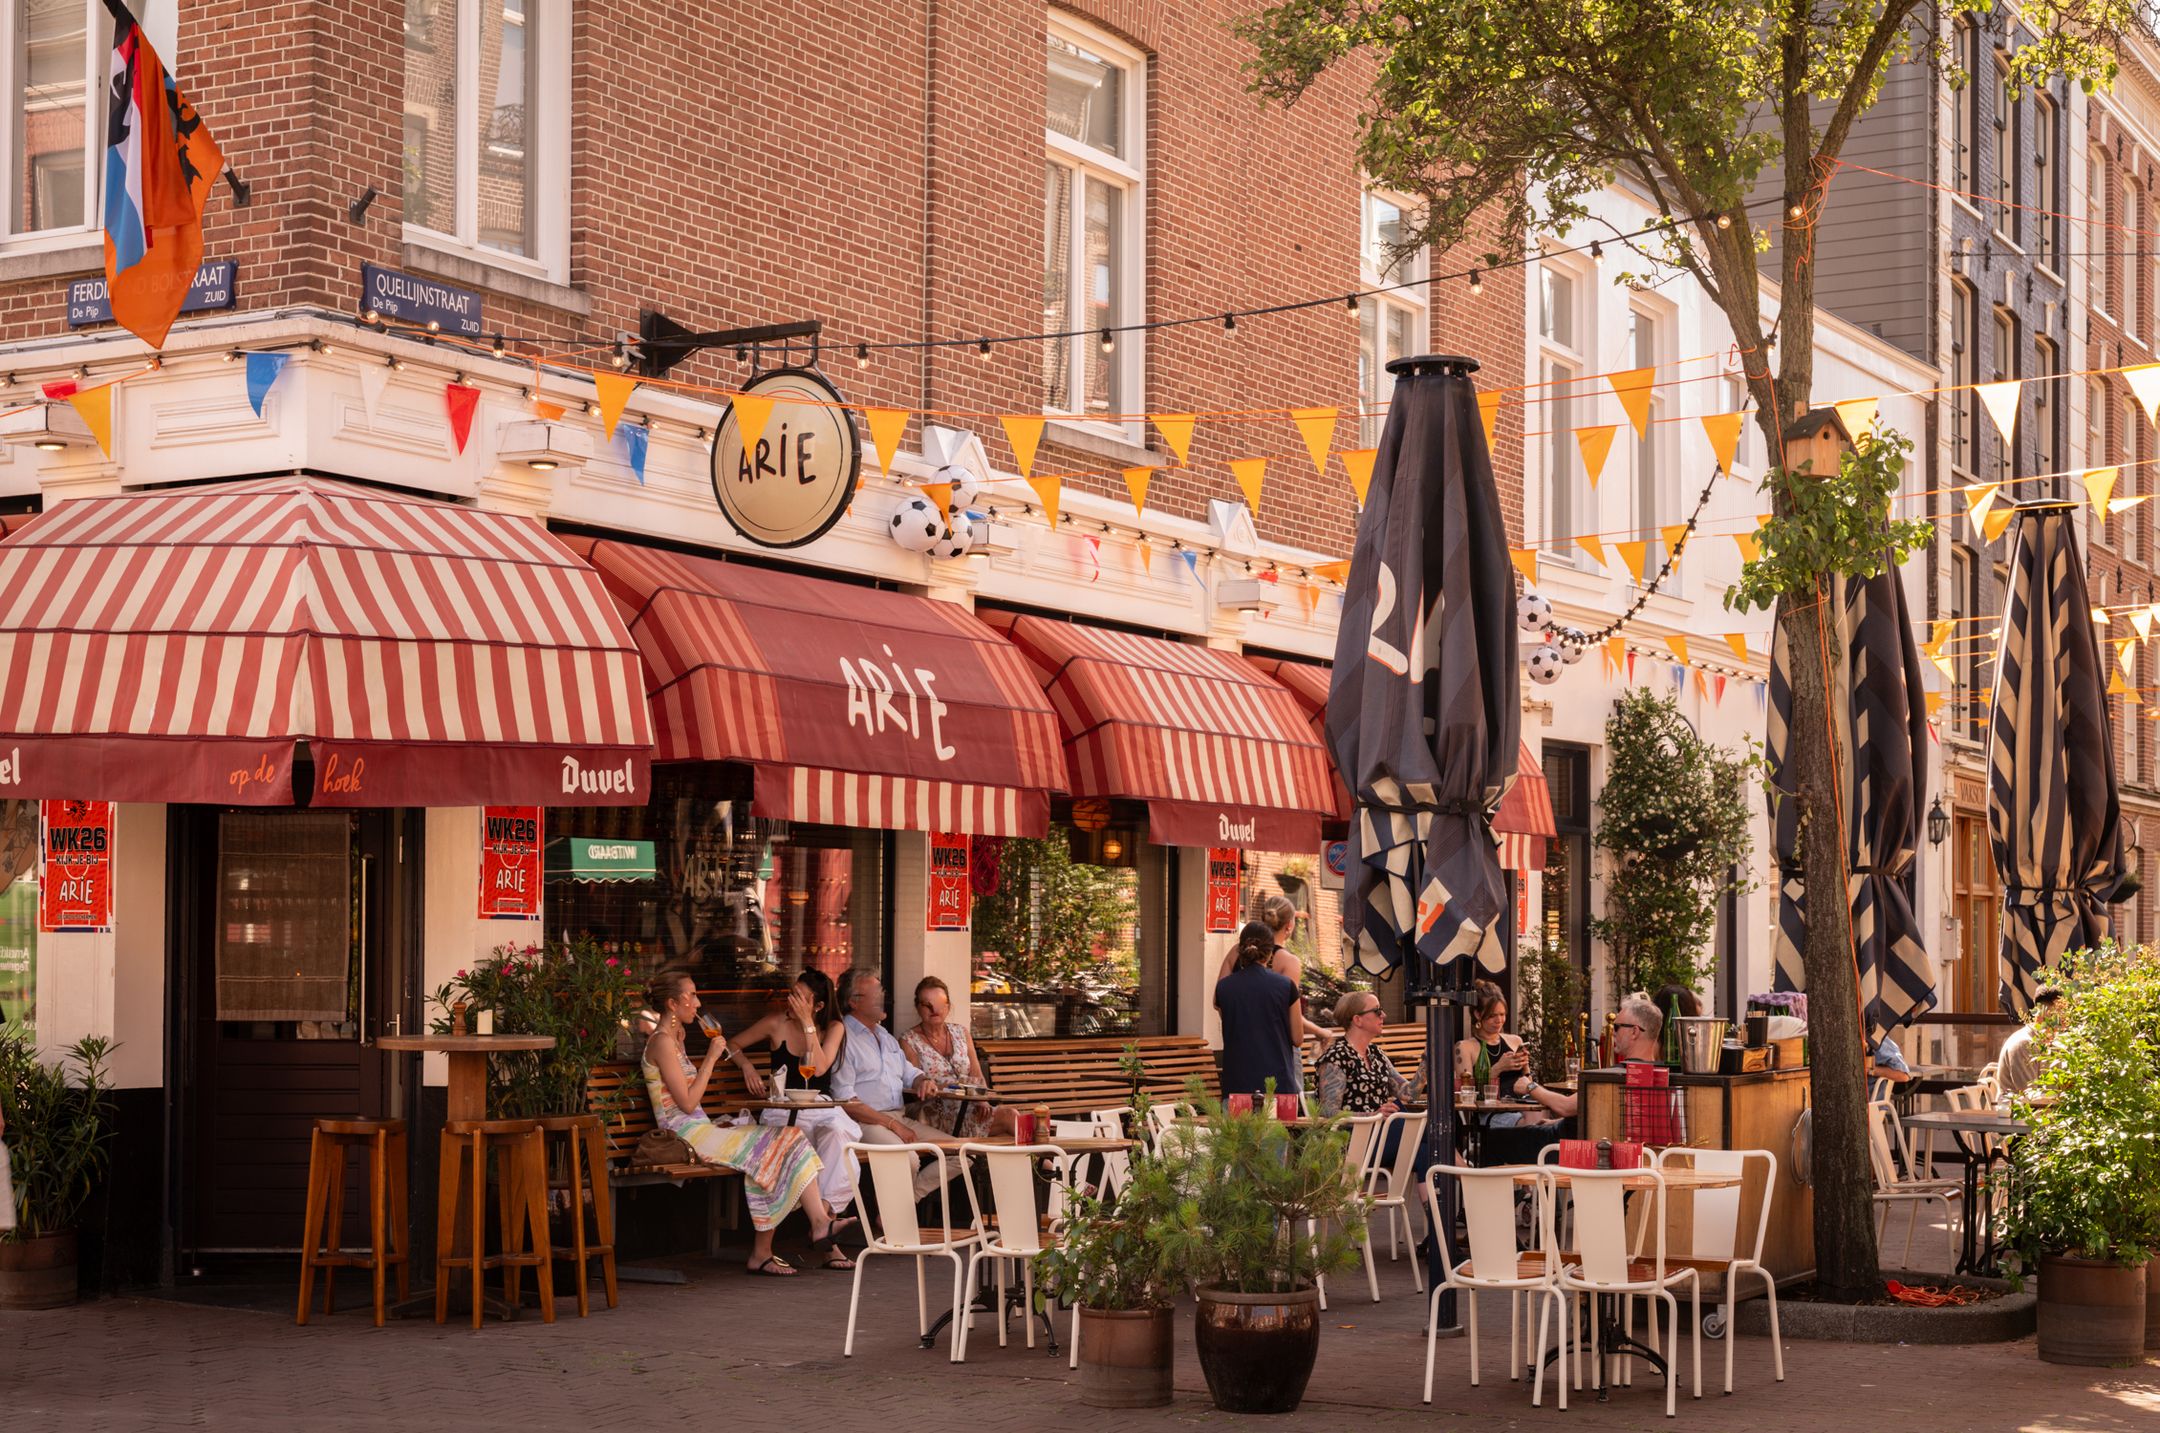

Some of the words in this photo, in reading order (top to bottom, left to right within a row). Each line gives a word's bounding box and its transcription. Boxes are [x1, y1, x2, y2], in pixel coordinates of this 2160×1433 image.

[204, 290, 226, 303] ZUID
[376, 274, 470, 315] QUELLIJNSTRAAT
[72, 308, 83, 318] De
[86, 306, 99, 319] Pijp
[372, 297, 383, 309] De
[385, 299, 398, 315] Pijp
[461, 318, 480, 333] ZUID
[230, 769, 251, 794] op
[254, 753, 275, 783] de
[323, 753, 364, 792] hoek
[562, 755, 635, 795] Duvel
[486, 816, 536, 842] WK26
[1219, 812, 1255, 843] Duvel
[50, 826, 106, 852] WK26
[56, 854, 73, 865] KIJK
[75, 854, 84, 865] JE
[86, 854, 99, 865] BIJ
[933, 847, 966, 867] WK26
[1211, 861, 1236, 878] WK26
